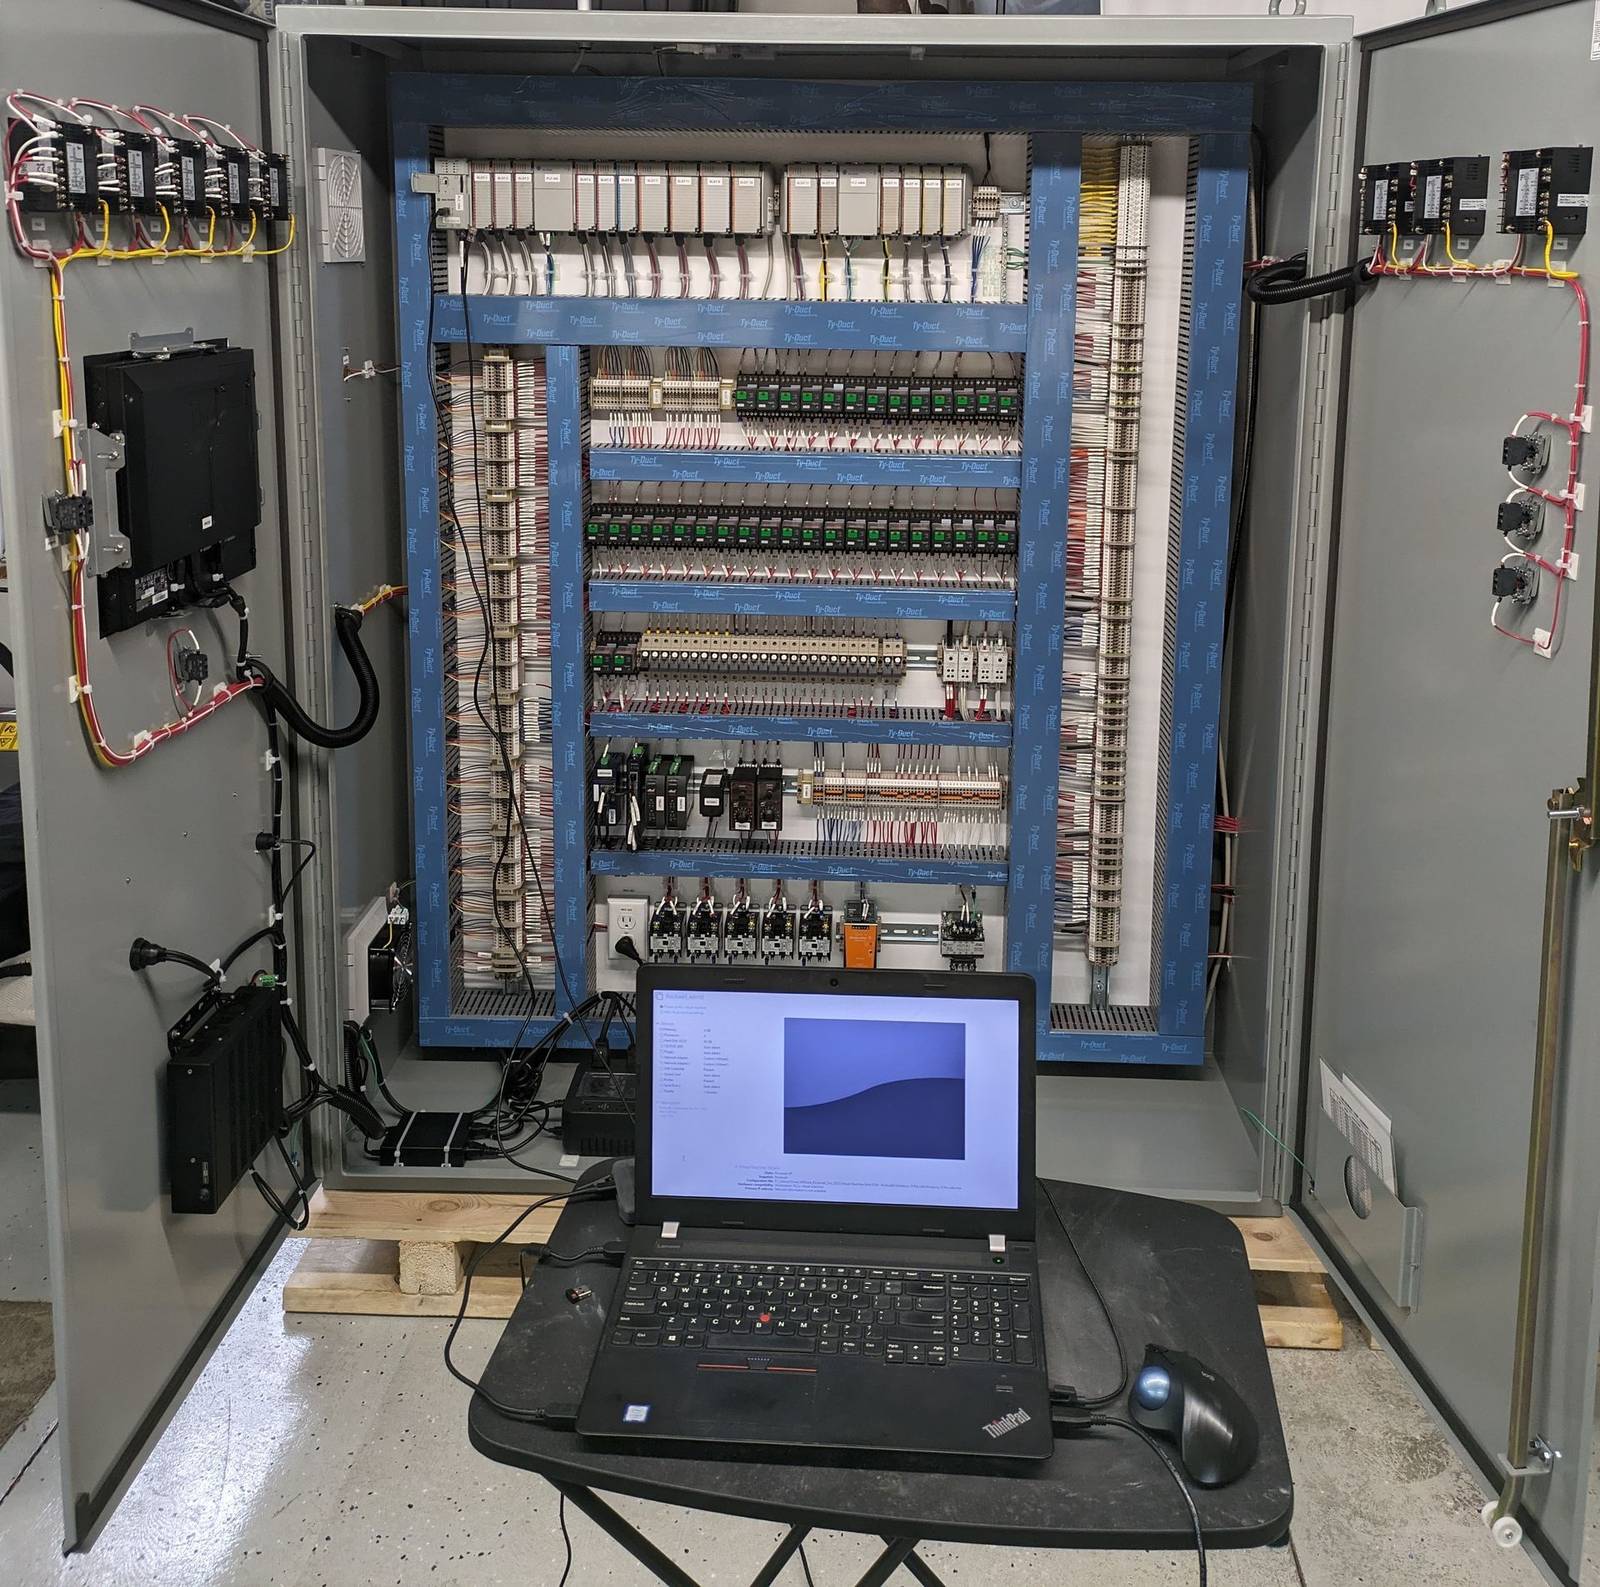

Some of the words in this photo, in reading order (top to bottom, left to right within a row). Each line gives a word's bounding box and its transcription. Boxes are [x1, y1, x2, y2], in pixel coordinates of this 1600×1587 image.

[526, 300, 553, 309] Ty-Duct
[611, 302, 639, 312] Ty-Duct
[697, 304, 725, 314] Ty-Duct
[784, 305, 811, 316] Ty-Duct
[870, 306, 898, 316] Ty-Duct
[955, 307, 983, 317] Ty-Duct
[483, 314, 511, 323] Ty-Duct
[569, 315, 597, 325] Ty-Duct
[654, 316, 683, 326] Ty-Duct
[739, 318, 768, 329] Ty-Duct
[827, 320, 854, 330] Ty-Duct
[912, 321, 940, 332] Ty-Duct
[999, 322, 1026, 332] Ty-Duct
[440, 328, 466, 337] Ty-Duct
[526, 328, 554, 338] Ty-Duct
[611, 330, 639, 340] Ty-Duct
[697, 331, 725, 342] Ty-Duct
[784, 333, 811, 343] Ty-Duct
[869, 334, 897, 344] Ty-Duct
[955, 336, 983, 346] Ty-Duct
[630, 456, 657, 465] Ty-Duct
[714, 457, 740, 466] Ty-Duct
[796, 459, 822, 468] Ty-Duct
[878, 461, 904, 470] Ty-Duct
[961, 462, 988, 471] Ty-Duct
[672, 470, 699, 479] Ty-Duct
[754, 471, 781, 481] Ty-Duct
[836, 473, 863, 482] Ty-Duct
[919, 474, 946, 483] Ty-Duct
[611, 587, 637, 596] Ty-Duct
[693, 589, 720, 598] Ty-Duct
[775, 591, 800, 600] Ty-Duct
[855, 593, 882, 601] Ty-Duct
[938, 595, 965, 604] Ty-Duct
[652, 601, 680, 610] Ty-Duct
[734, 603, 760, 612] Ty-Duct
[815, 604, 841, 614] Ty-Duct
[896, 607, 923, 616] Ty-Duct
[979, 609, 1006, 618] Ty-Duct
[728, 724, 753, 734] Ty-Duct
[807, 727, 833, 736] Ty-Duct
[888, 729, 914, 738] Ty-Duct
[669, 860, 695, 869] Ty-Duct
[827, 866, 853, 874] Ty-Duct
[908, 868, 934, 877] Ty-Duct
[1080, 1041, 1107, 1049] Ty-Duct
[982, 1408, 1031, 1438] ThinkPad
